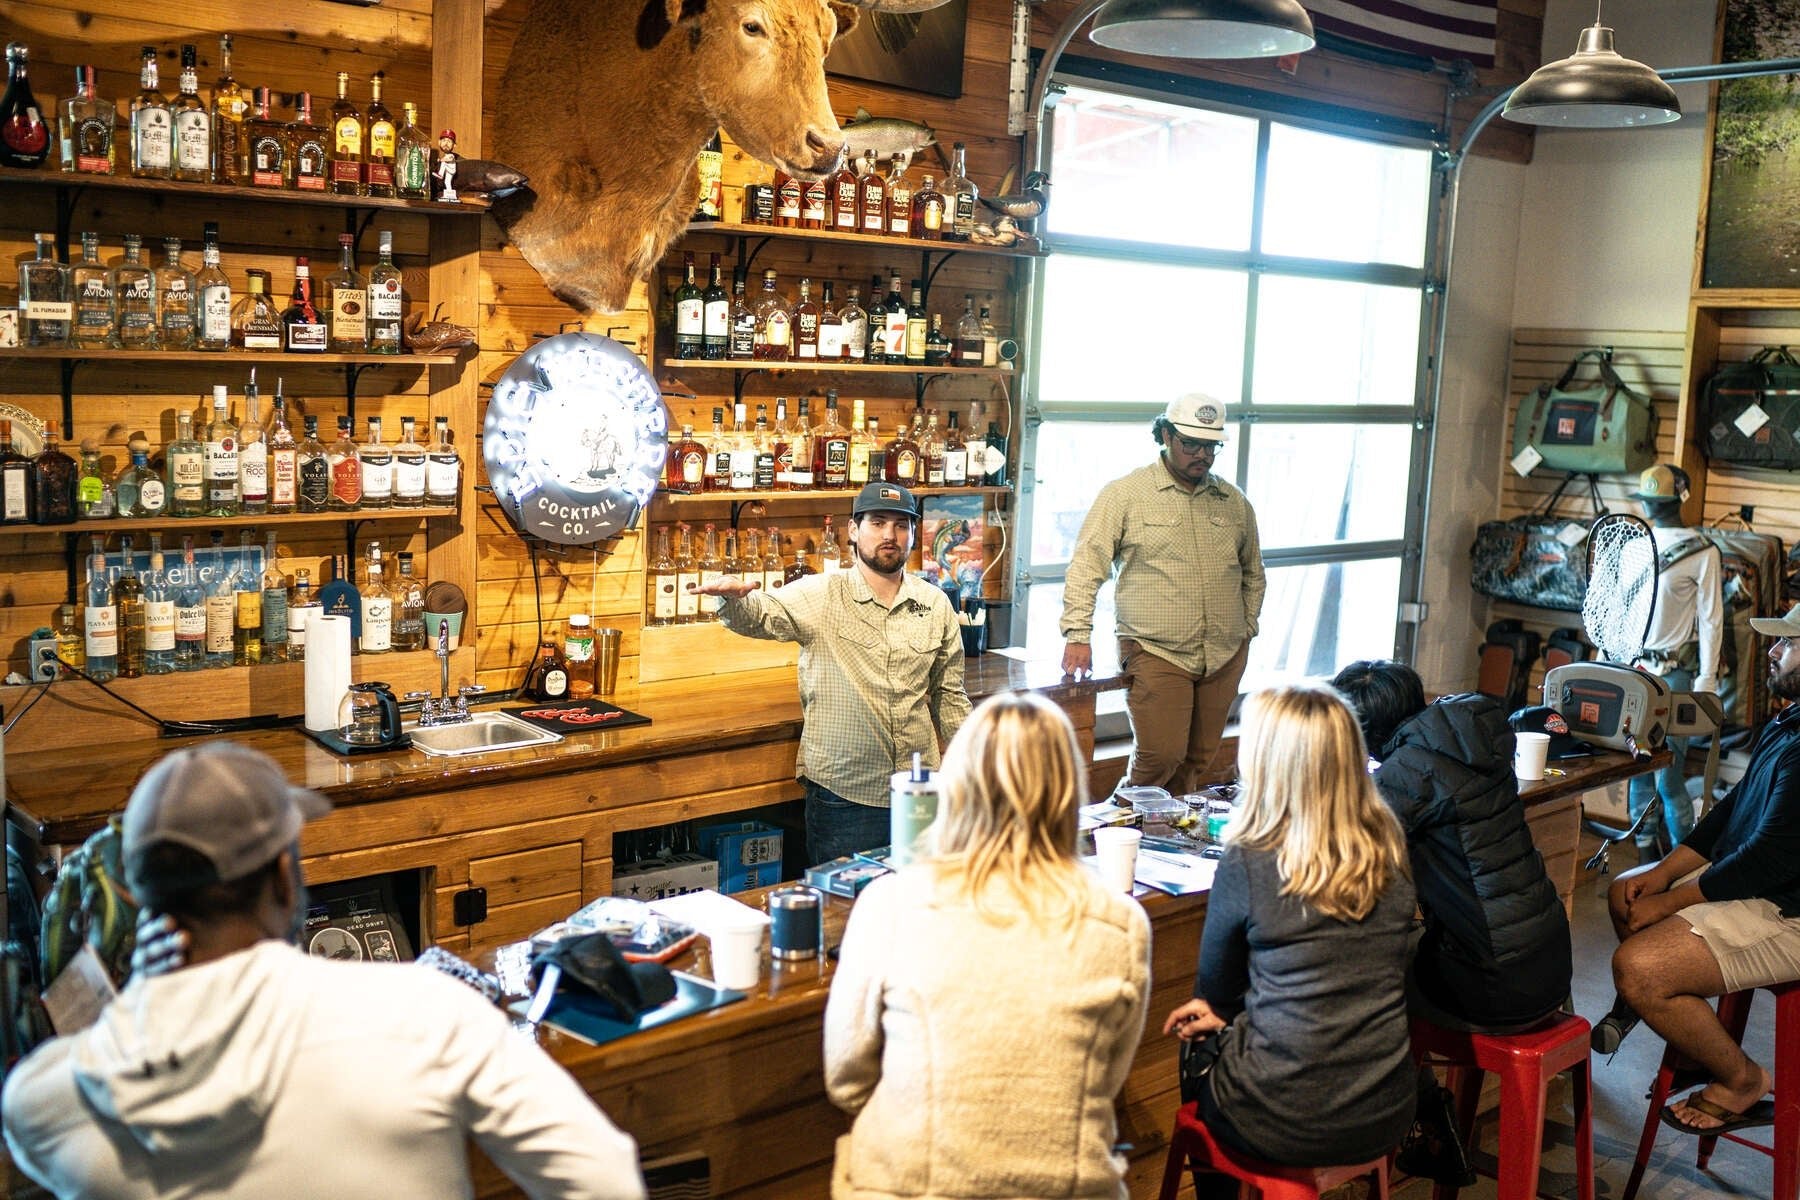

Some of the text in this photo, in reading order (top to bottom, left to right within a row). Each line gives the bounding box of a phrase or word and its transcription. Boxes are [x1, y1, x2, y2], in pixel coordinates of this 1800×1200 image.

[412, 151, 420, 186] HORNITOS
[338, 291, 363, 300] Tito's
[378, 292, 401, 300] BACAR
[890, 323, 906, 353] 7
[213, 452, 238, 460] BACAR
[246, 467, 266, 476] ROC
[538, 497, 617, 521] COCKTAIL
[562, 522, 590, 536] CO.
[179, 610, 197, 619] Dulce
[346, 920, 385, 932] DEAD DRIFT
